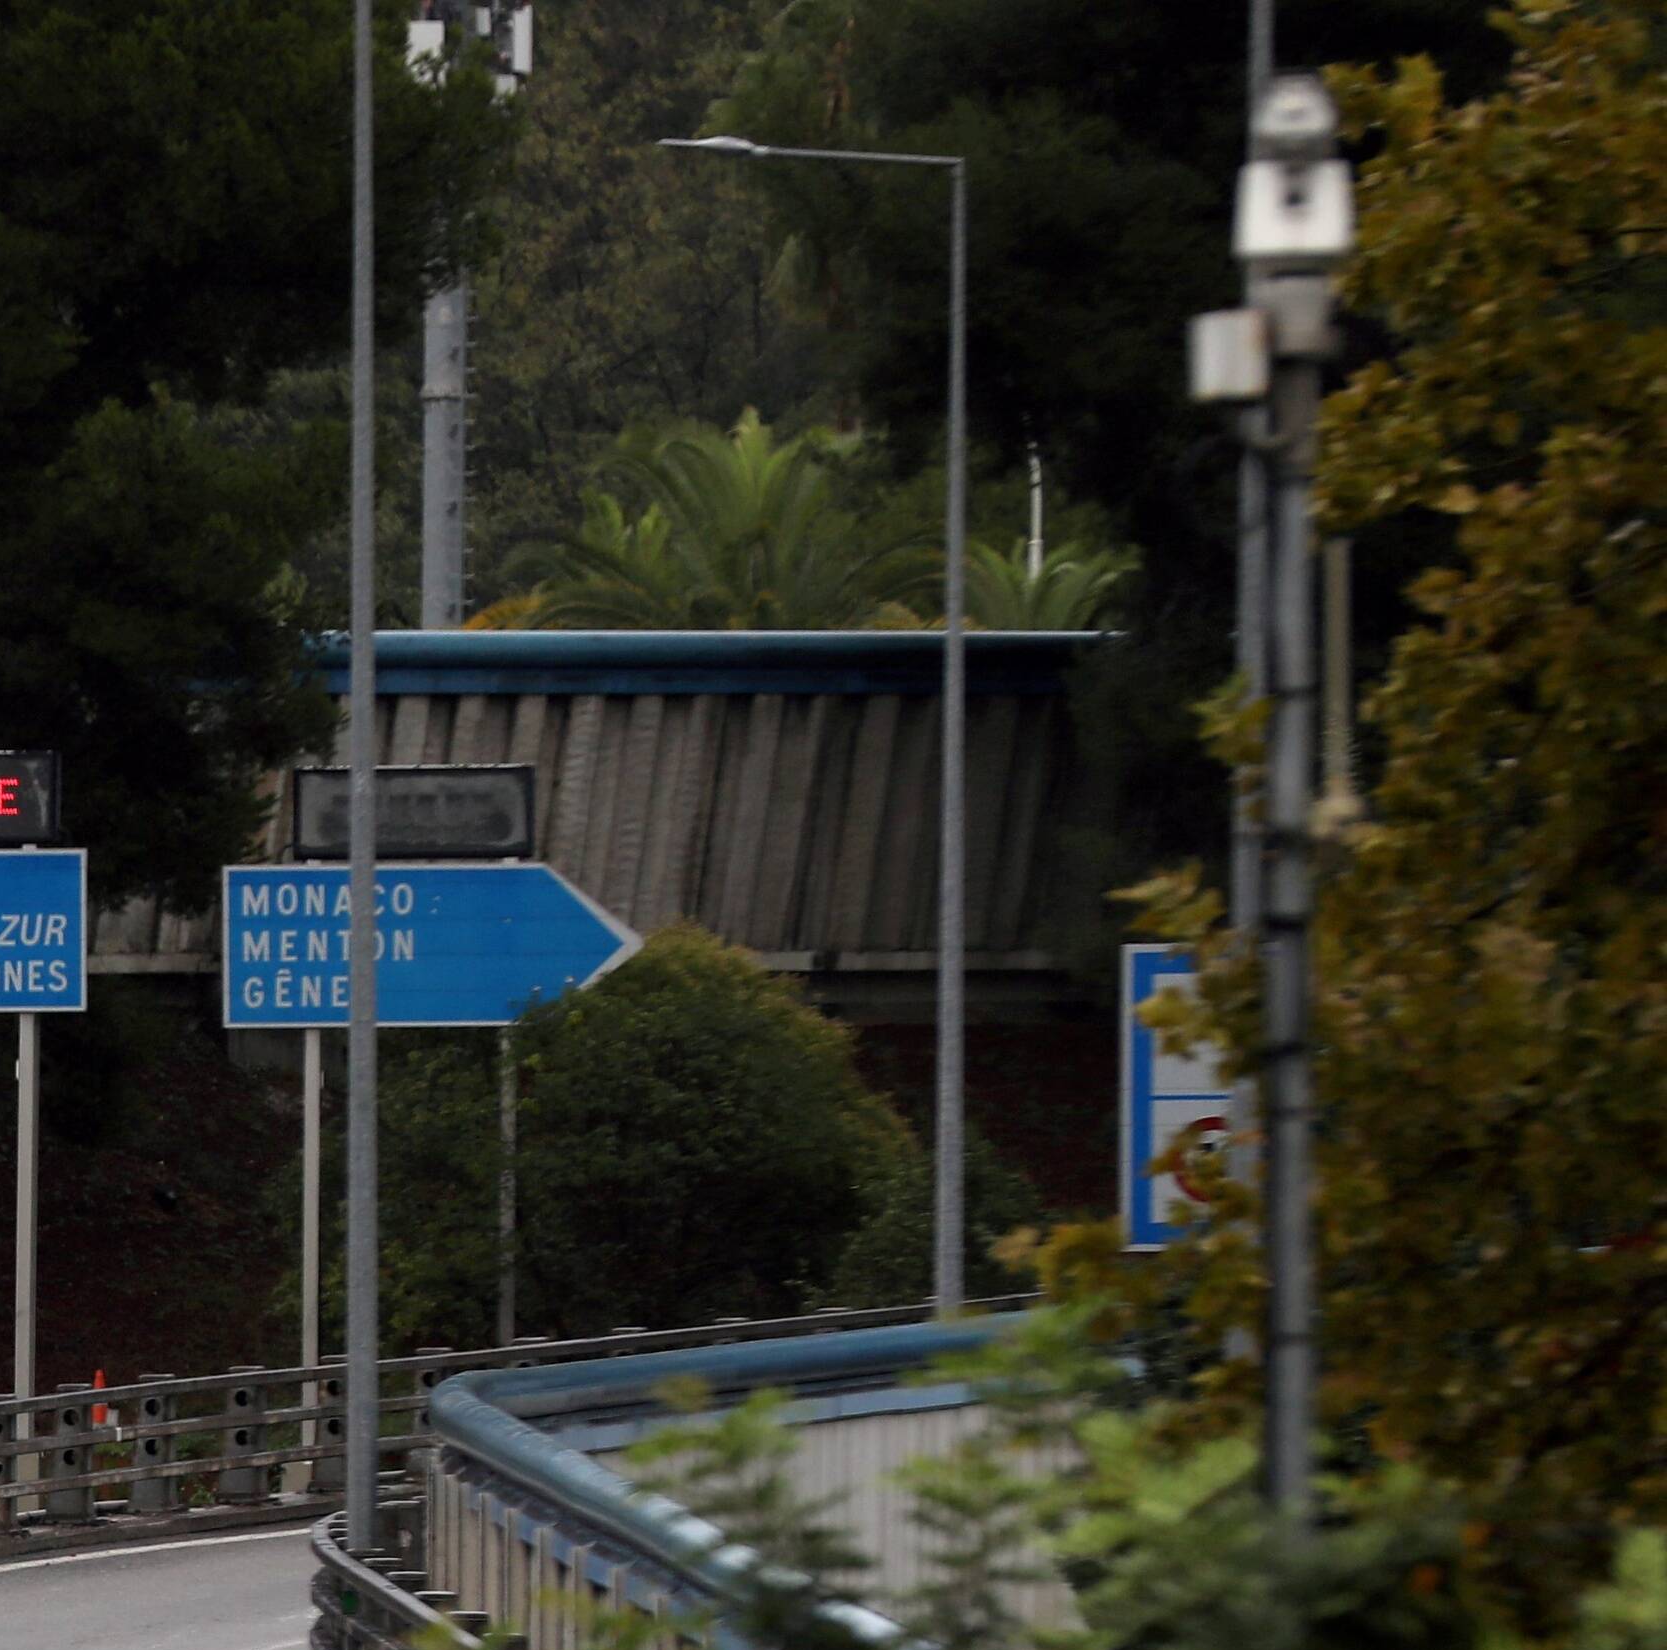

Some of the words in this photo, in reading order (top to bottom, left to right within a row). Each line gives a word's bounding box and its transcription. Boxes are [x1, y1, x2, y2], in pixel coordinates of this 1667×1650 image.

[242, 883, 415, 915] MONACO
[242, 929, 415, 962] MENTON
[243, 969, 352, 1008] GÊNE
